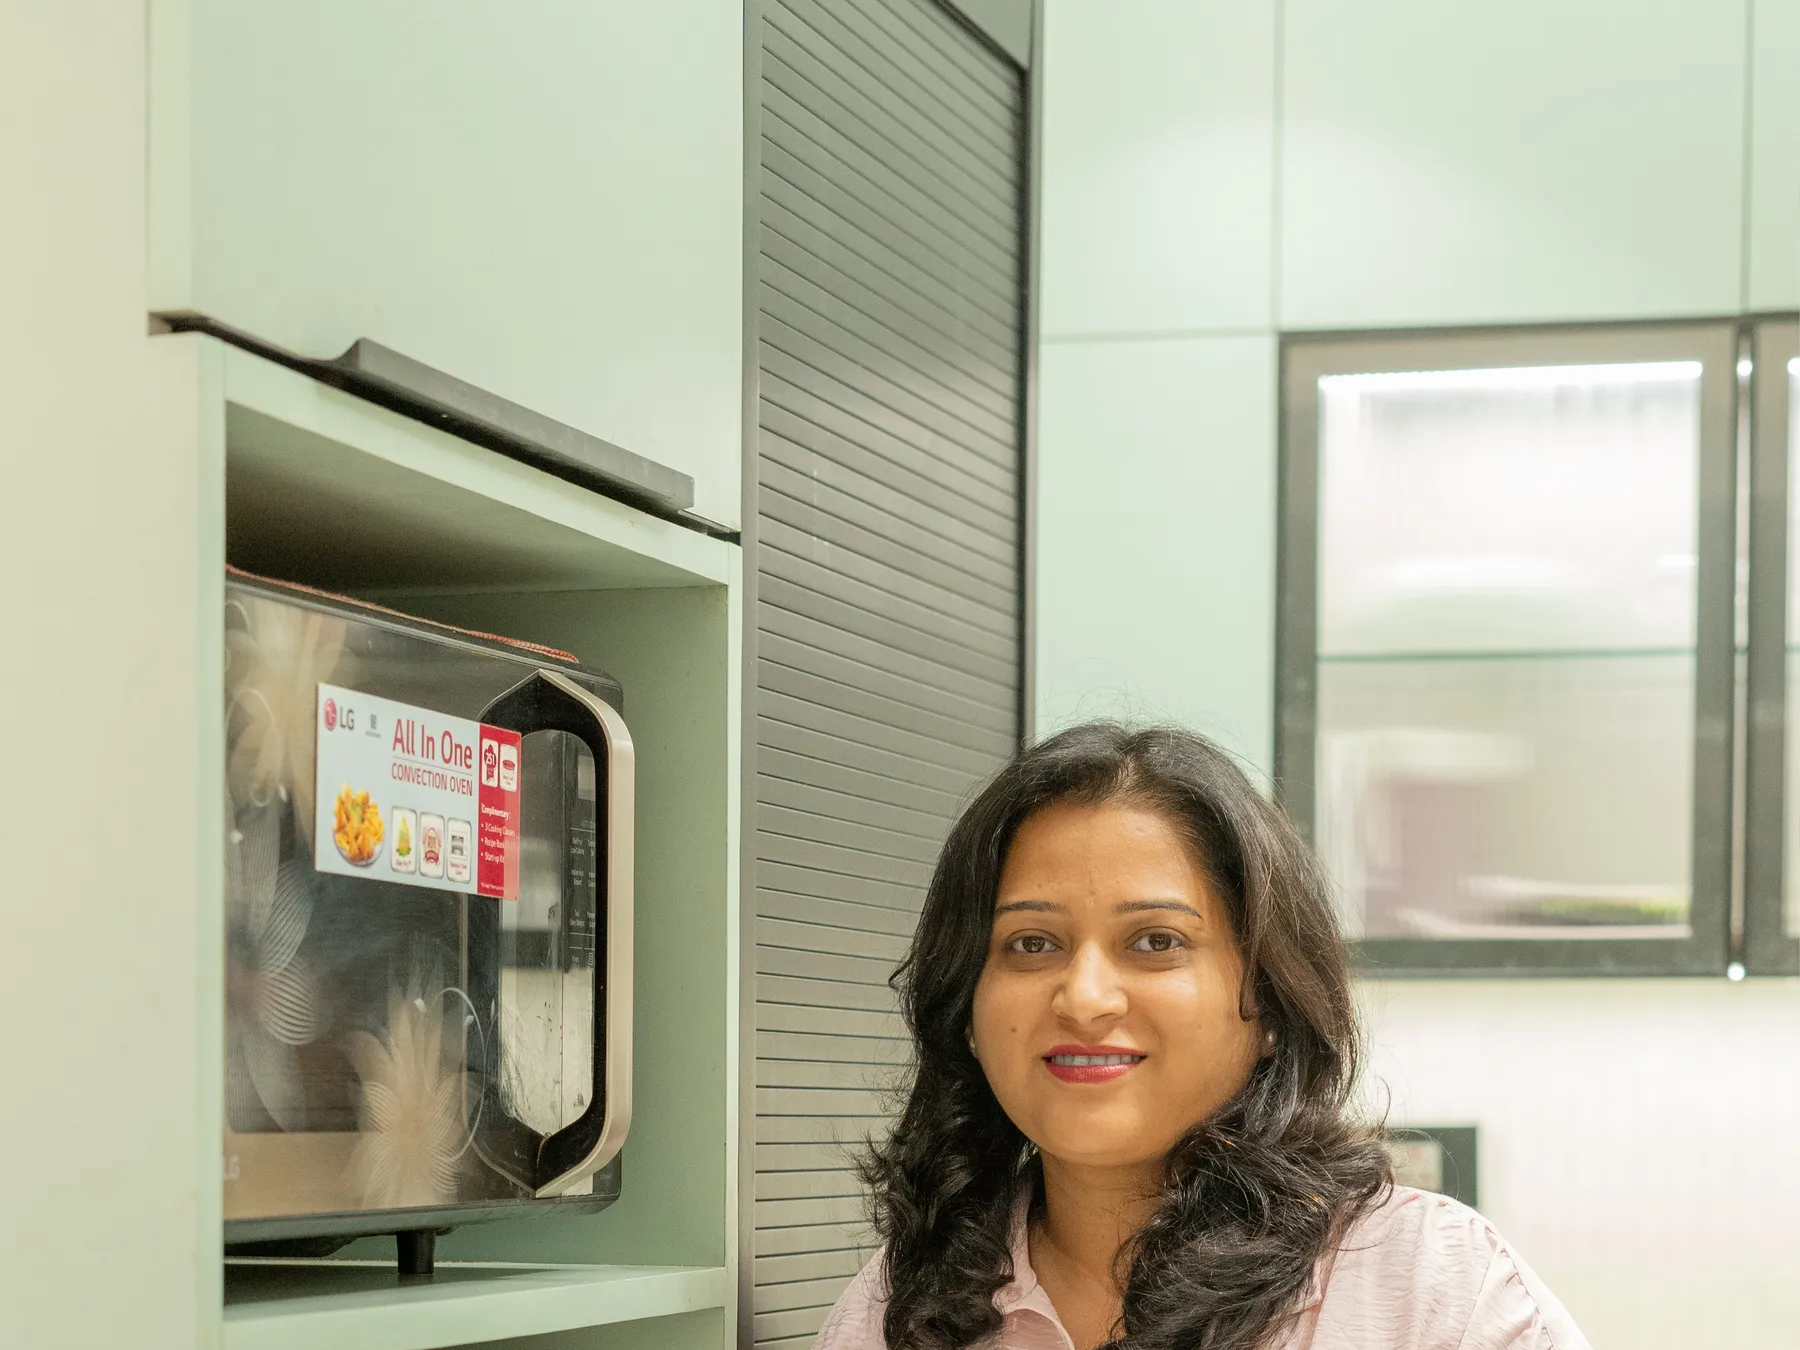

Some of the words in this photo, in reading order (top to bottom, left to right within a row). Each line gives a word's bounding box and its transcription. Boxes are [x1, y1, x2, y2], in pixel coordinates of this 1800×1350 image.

[340, 706, 355, 731] LG
[392, 718, 415, 757] All
[421, 724, 435, 760] In
[441, 730, 473, 769] One
[391, 762, 447, 791] CONVECTION
[449, 776, 473, 797] OVEN
